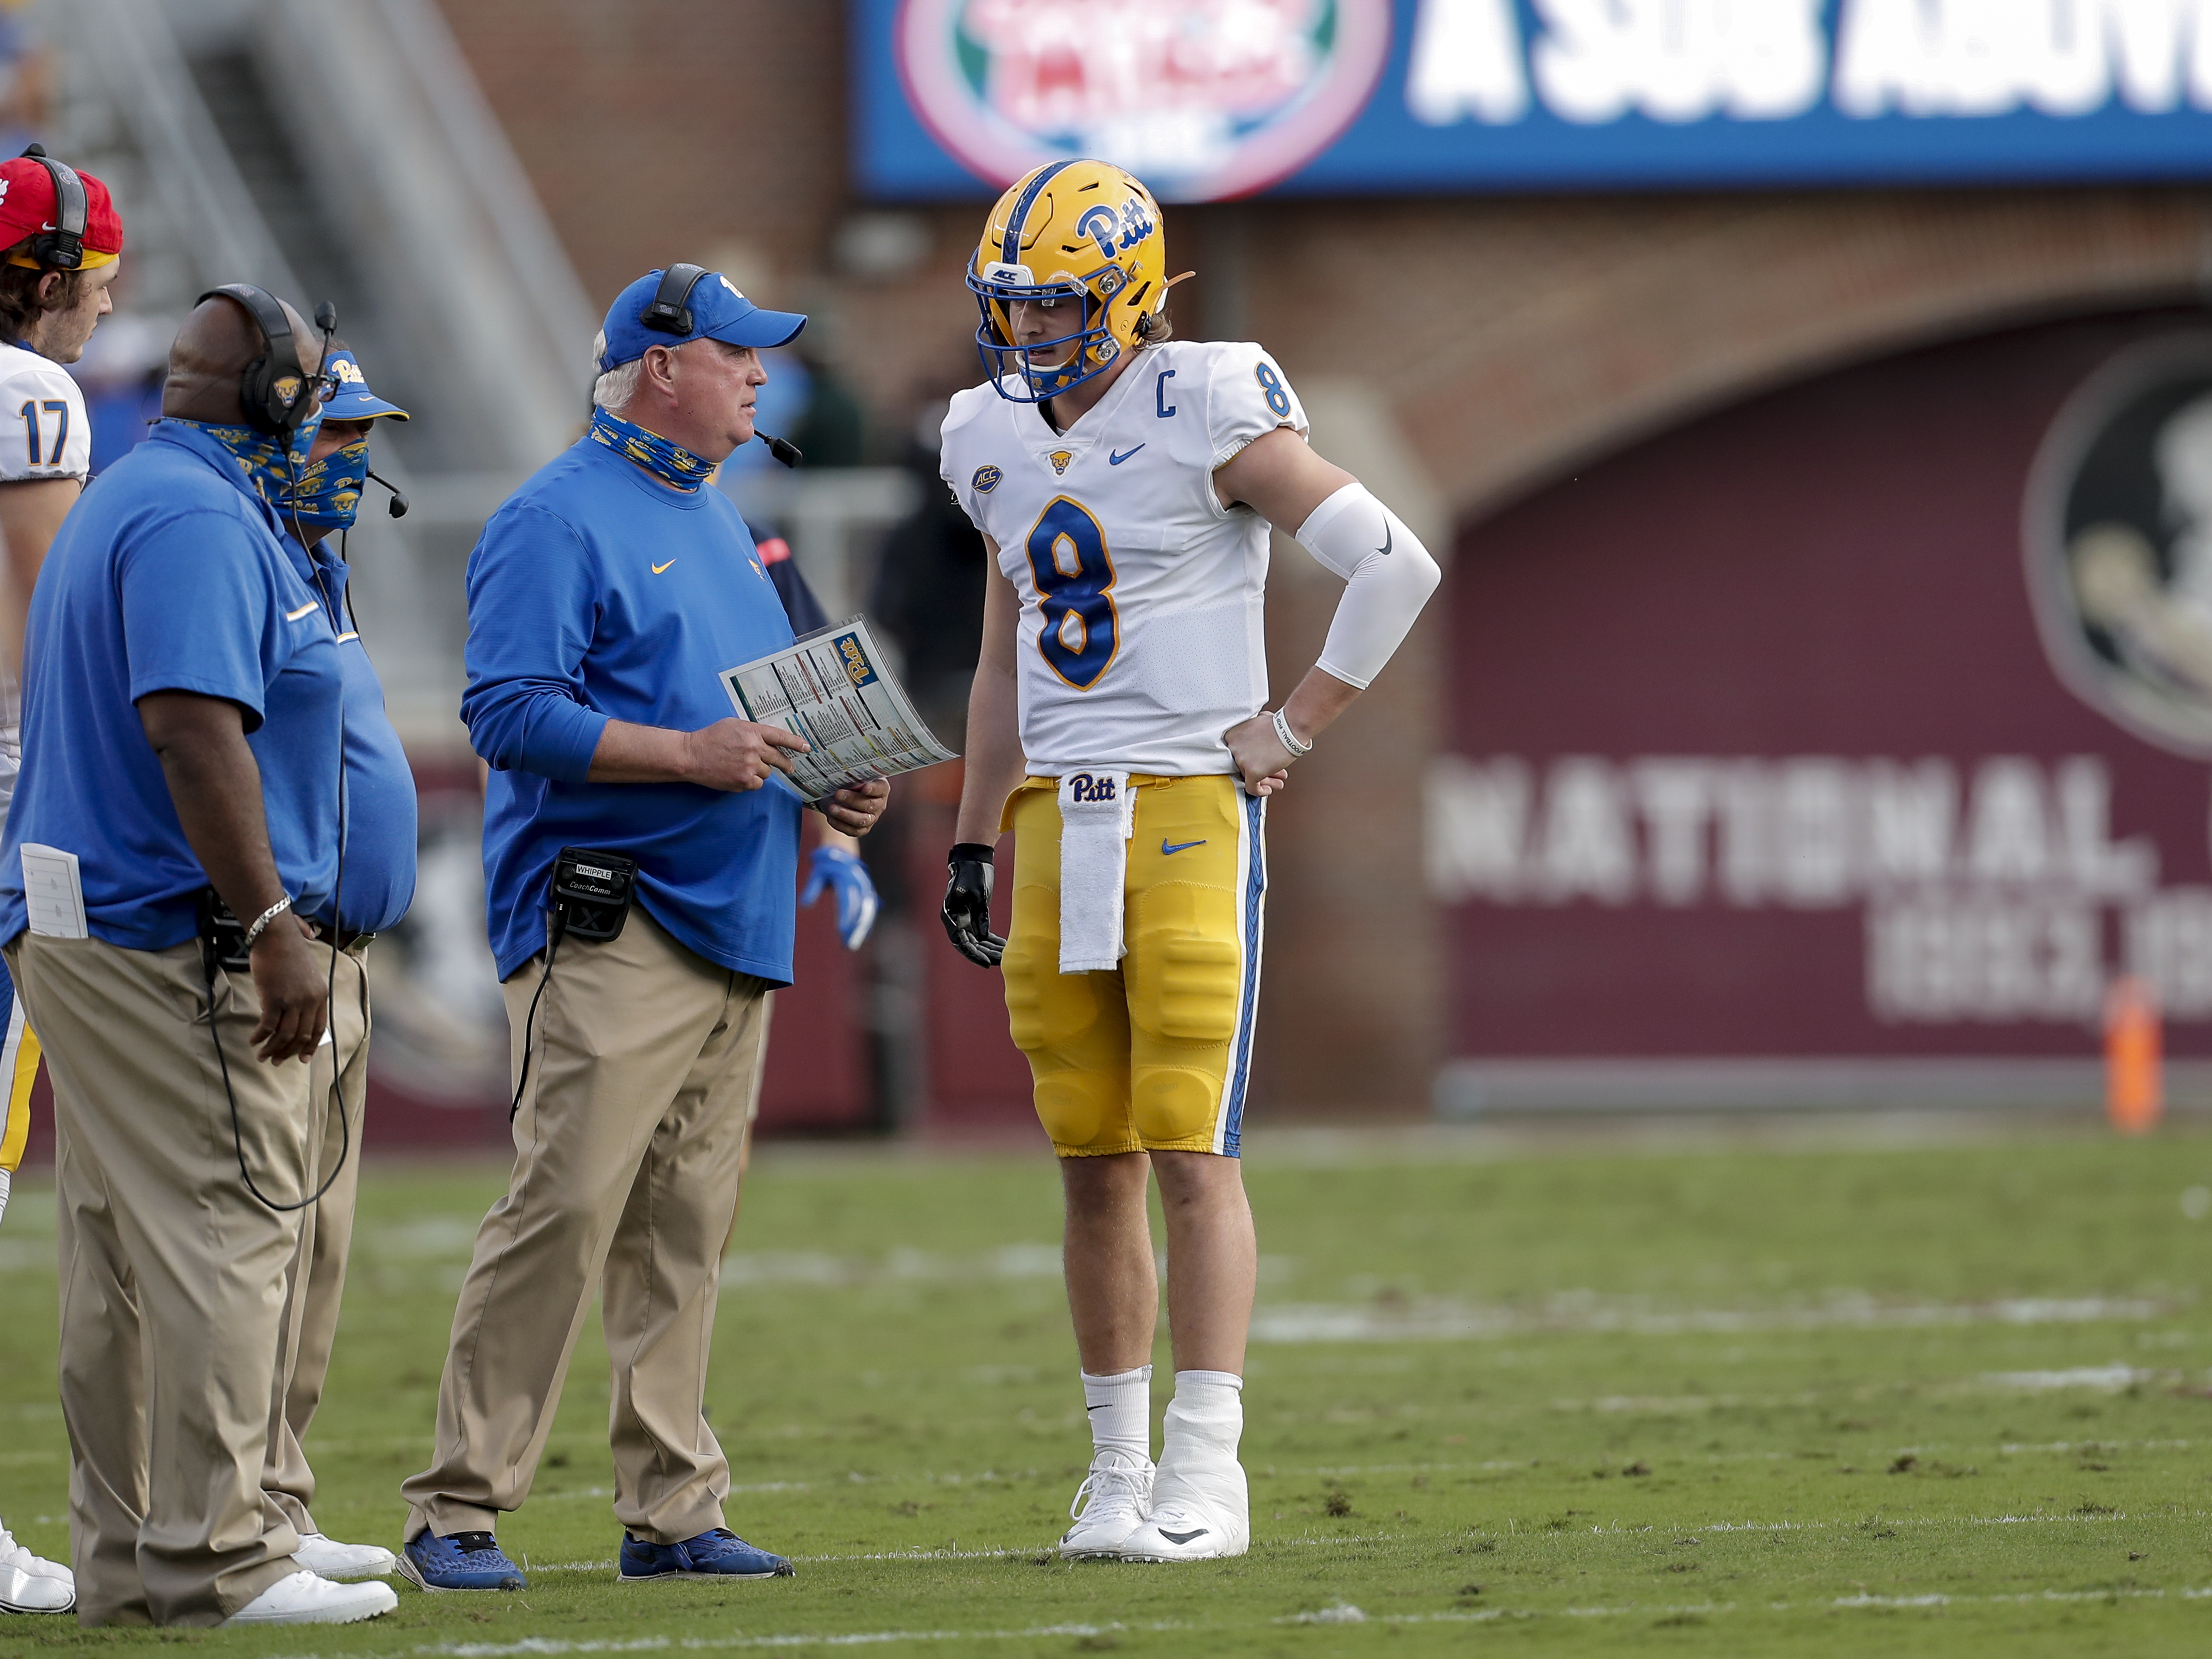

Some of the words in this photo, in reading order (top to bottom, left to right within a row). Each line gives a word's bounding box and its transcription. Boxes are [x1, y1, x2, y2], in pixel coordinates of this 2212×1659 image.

[1075, 197, 1155, 260] Pitt
[993, 270, 1018, 281] ACC
[331, 359, 365, 383] Pitt
[1156, 370, 1176, 418] C
[1254, 360, 1291, 420] 8
[19, 399, 70, 466] 17
[976, 469, 997, 485] ACC
[1025, 494, 1120, 691] 8
[840, 637, 870, 685] Pitt
[1282, 729, 1301, 753] FOOTBALL
[1068, 772, 1116, 802] Pitt
[577, 865, 611, 879] WHIPPLE
[570, 881, 611, 895] CoachComm
